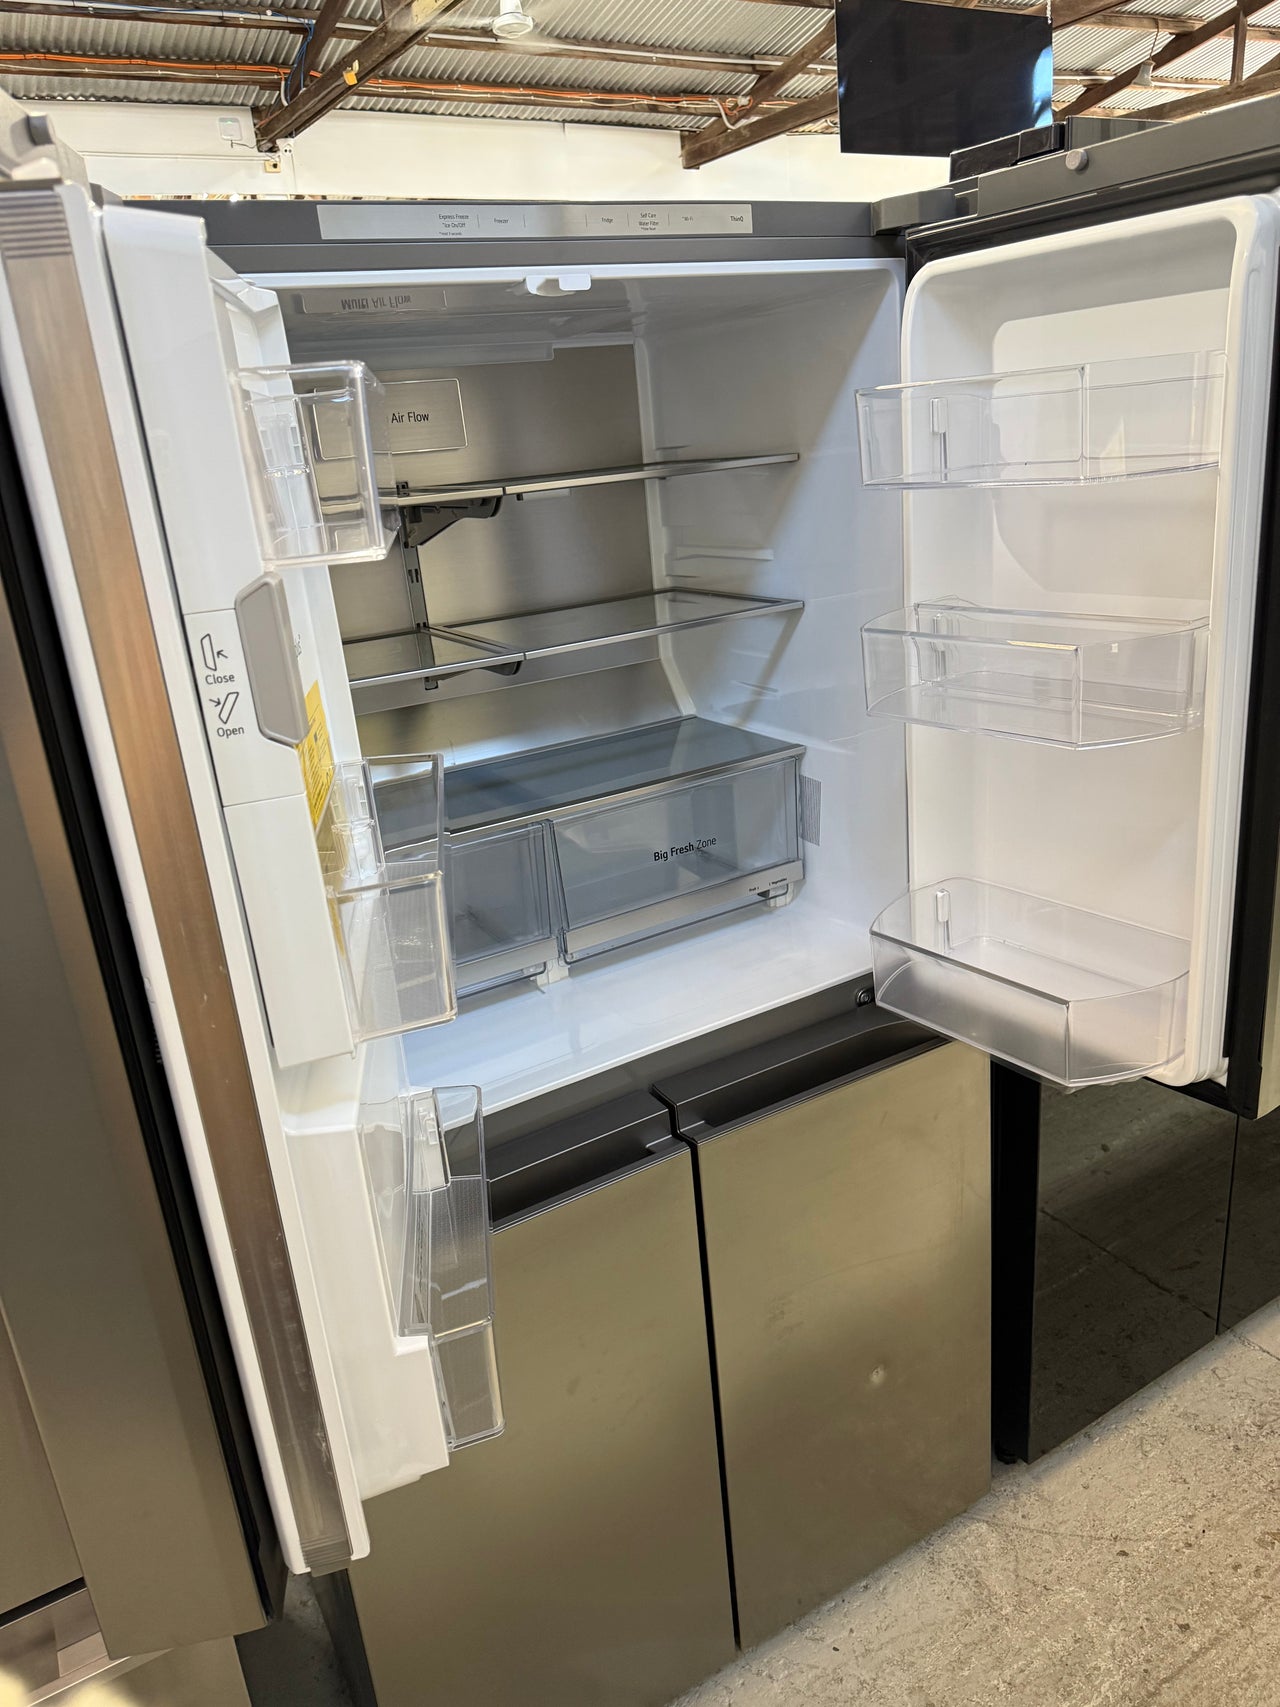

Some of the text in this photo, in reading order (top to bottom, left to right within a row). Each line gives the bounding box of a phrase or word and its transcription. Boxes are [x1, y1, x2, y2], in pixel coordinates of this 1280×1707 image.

[391, 411, 430, 424] Air Flow
[205, 674, 236, 685] Close
[216, 726, 245, 739] Open
[653, 837, 717, 862] Big Fresh Zone
